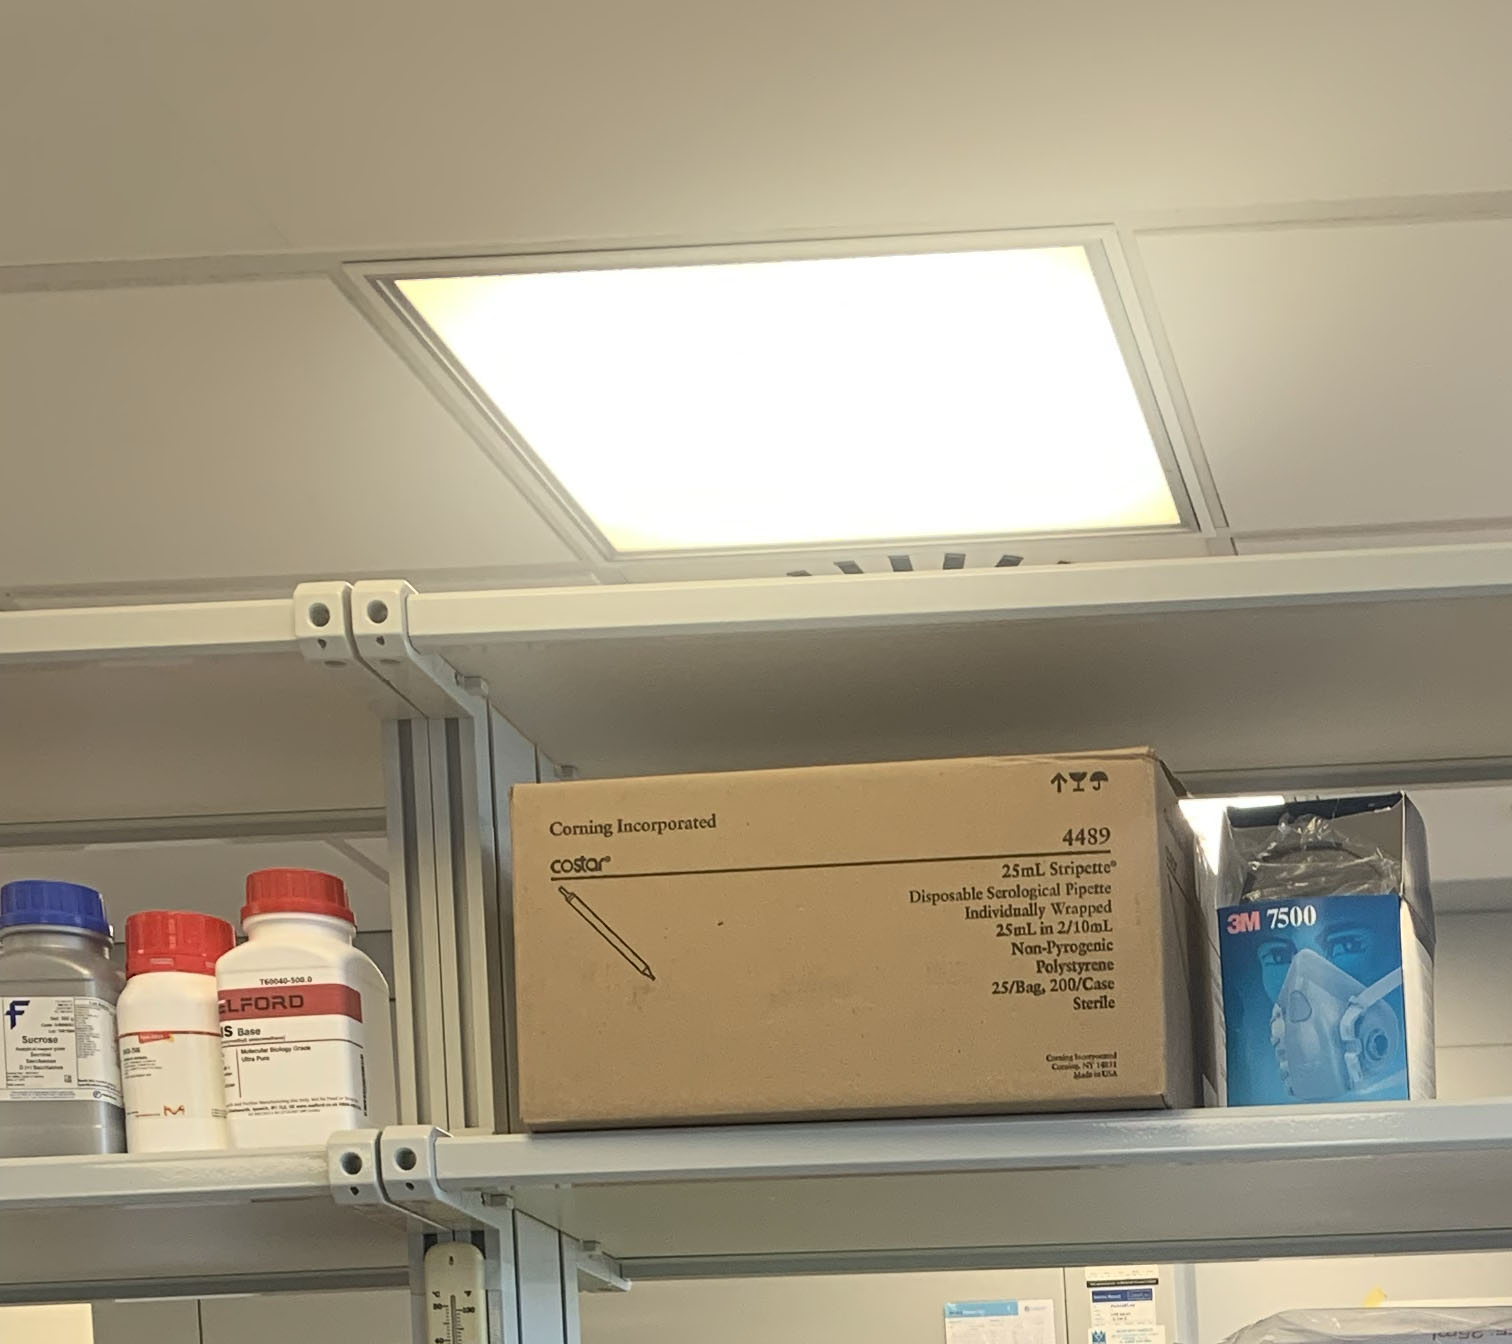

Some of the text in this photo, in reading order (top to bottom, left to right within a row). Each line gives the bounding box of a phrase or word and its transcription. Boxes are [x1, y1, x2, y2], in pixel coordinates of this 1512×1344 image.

[549, 813, 717, 837] Corning Incorporated
[1062, 827, 1111, 847] 4489
[1001, 863, 1046, 879] 25mL
[909, 882, 1112, 905] Disposable Serological Pipette
[964, 900, 1113, 920] Individually Wrapped
[1226, 905, 1318, 935] 3M 7500
[995, 919, 1113, 937] 25mL in 2/10mL
[1011, 939, 1114, 956] Non-Pyrogenic
[1035, 959, 1115, 975] Polystyrene
[991, 977, 1116, 997] 25/Bag, 200/Case
[1072, 996, 1116, 1011] Sterile
